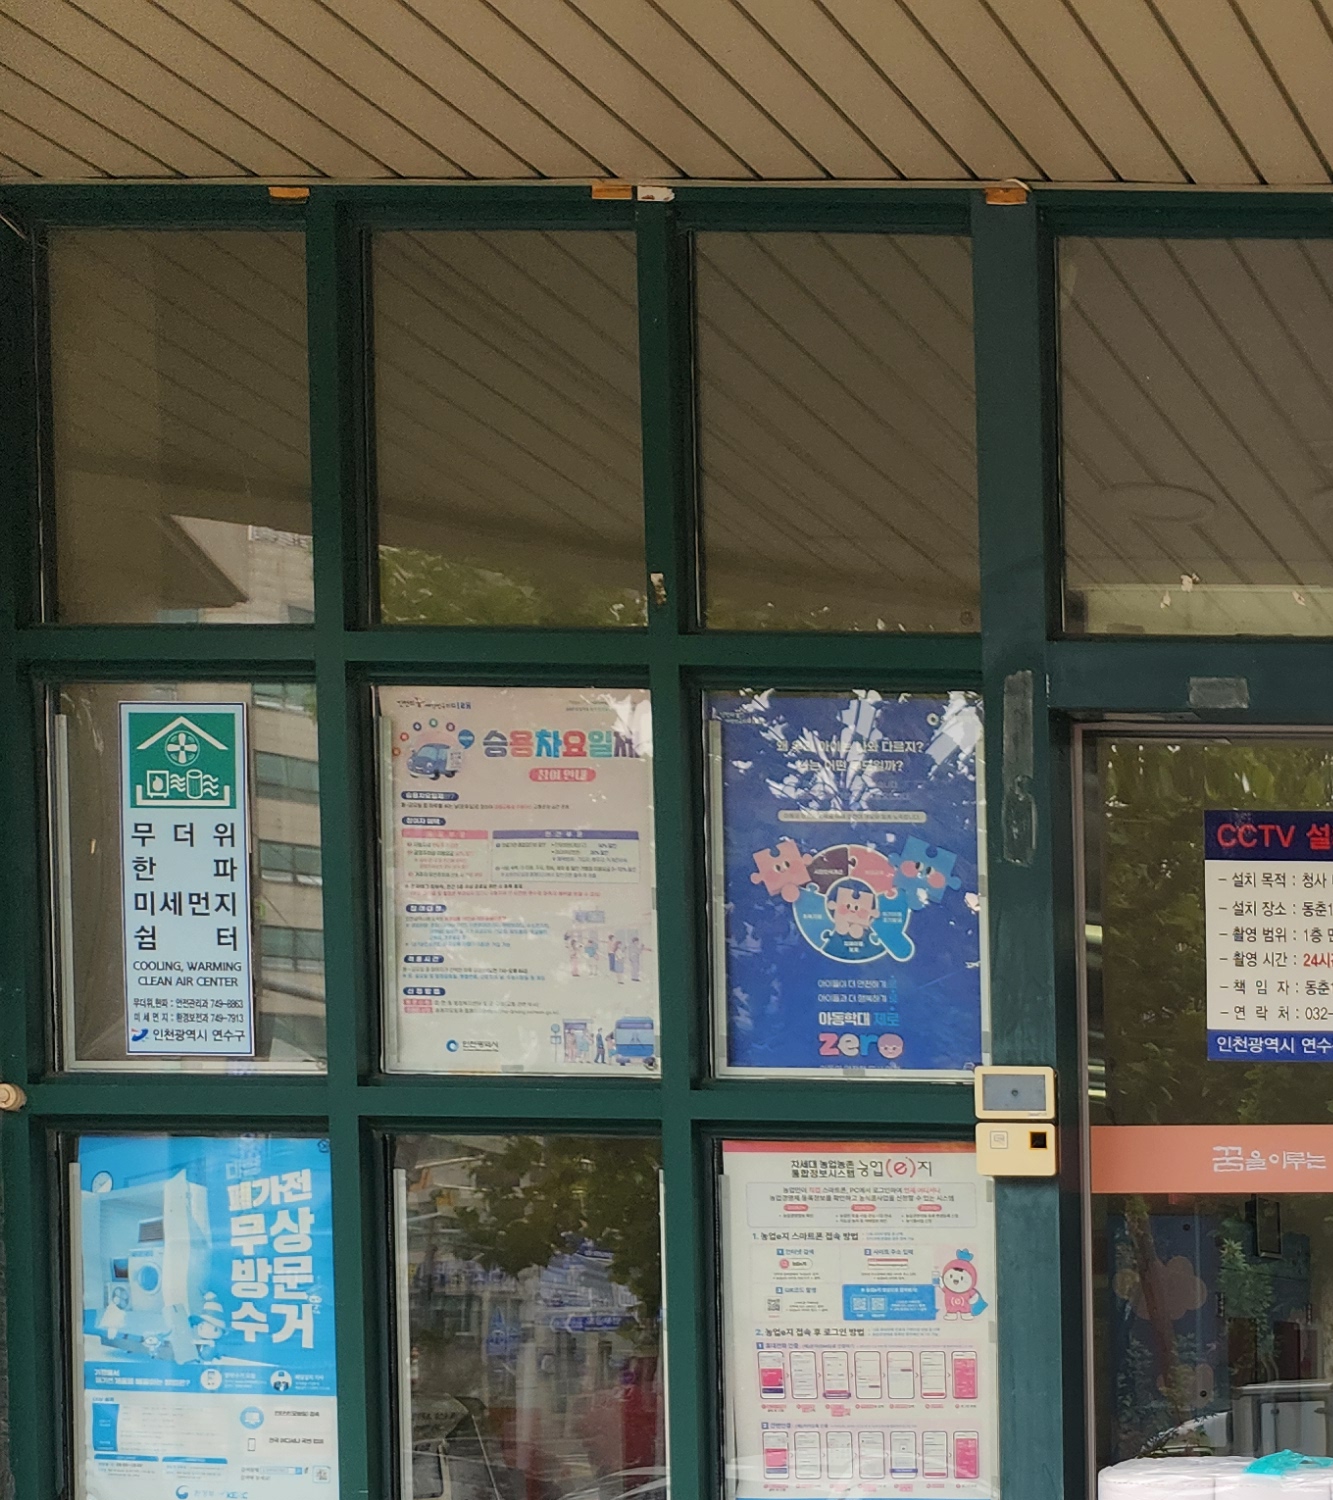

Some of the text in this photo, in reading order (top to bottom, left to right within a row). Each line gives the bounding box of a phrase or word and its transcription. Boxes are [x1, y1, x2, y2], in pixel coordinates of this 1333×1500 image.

[1217, 824, 1295, 848] CCTV
[1232, 872, 1256, 888] 설치
[1262, 872, 1286, 888] 목적
[1302, 872, 1326, 888] 청사
[134, 892, 237, 918] 미세먼지
[1232, 901, 1256, 916] 설치
[1262, 901, 1286, 917] 장소
[1232, 927, 1257, 942] 촬영
[1262, 927, 1287, 942] 범위
[1304, 928, 1322, 943] 1층
[133, 961, 241, 972] COOLING, WARMING
[1233, 951, 1257, 967] 촬영
[1263, 952, 1287, 967] 시간
[138, 977, 238, 986] CLEAN AIR CENTER
[819, 1012, 870, 1026] 아동학대
[153, 1029, 245, 1042] 인천광역시 연수구
[1217, 1036, 1295, 1053] 인천광역시
[230, 1207, 314, 1256] 무상
[231, 1256, 314, 1300] 방문
[231, 1301, 314, 1348] 수거
